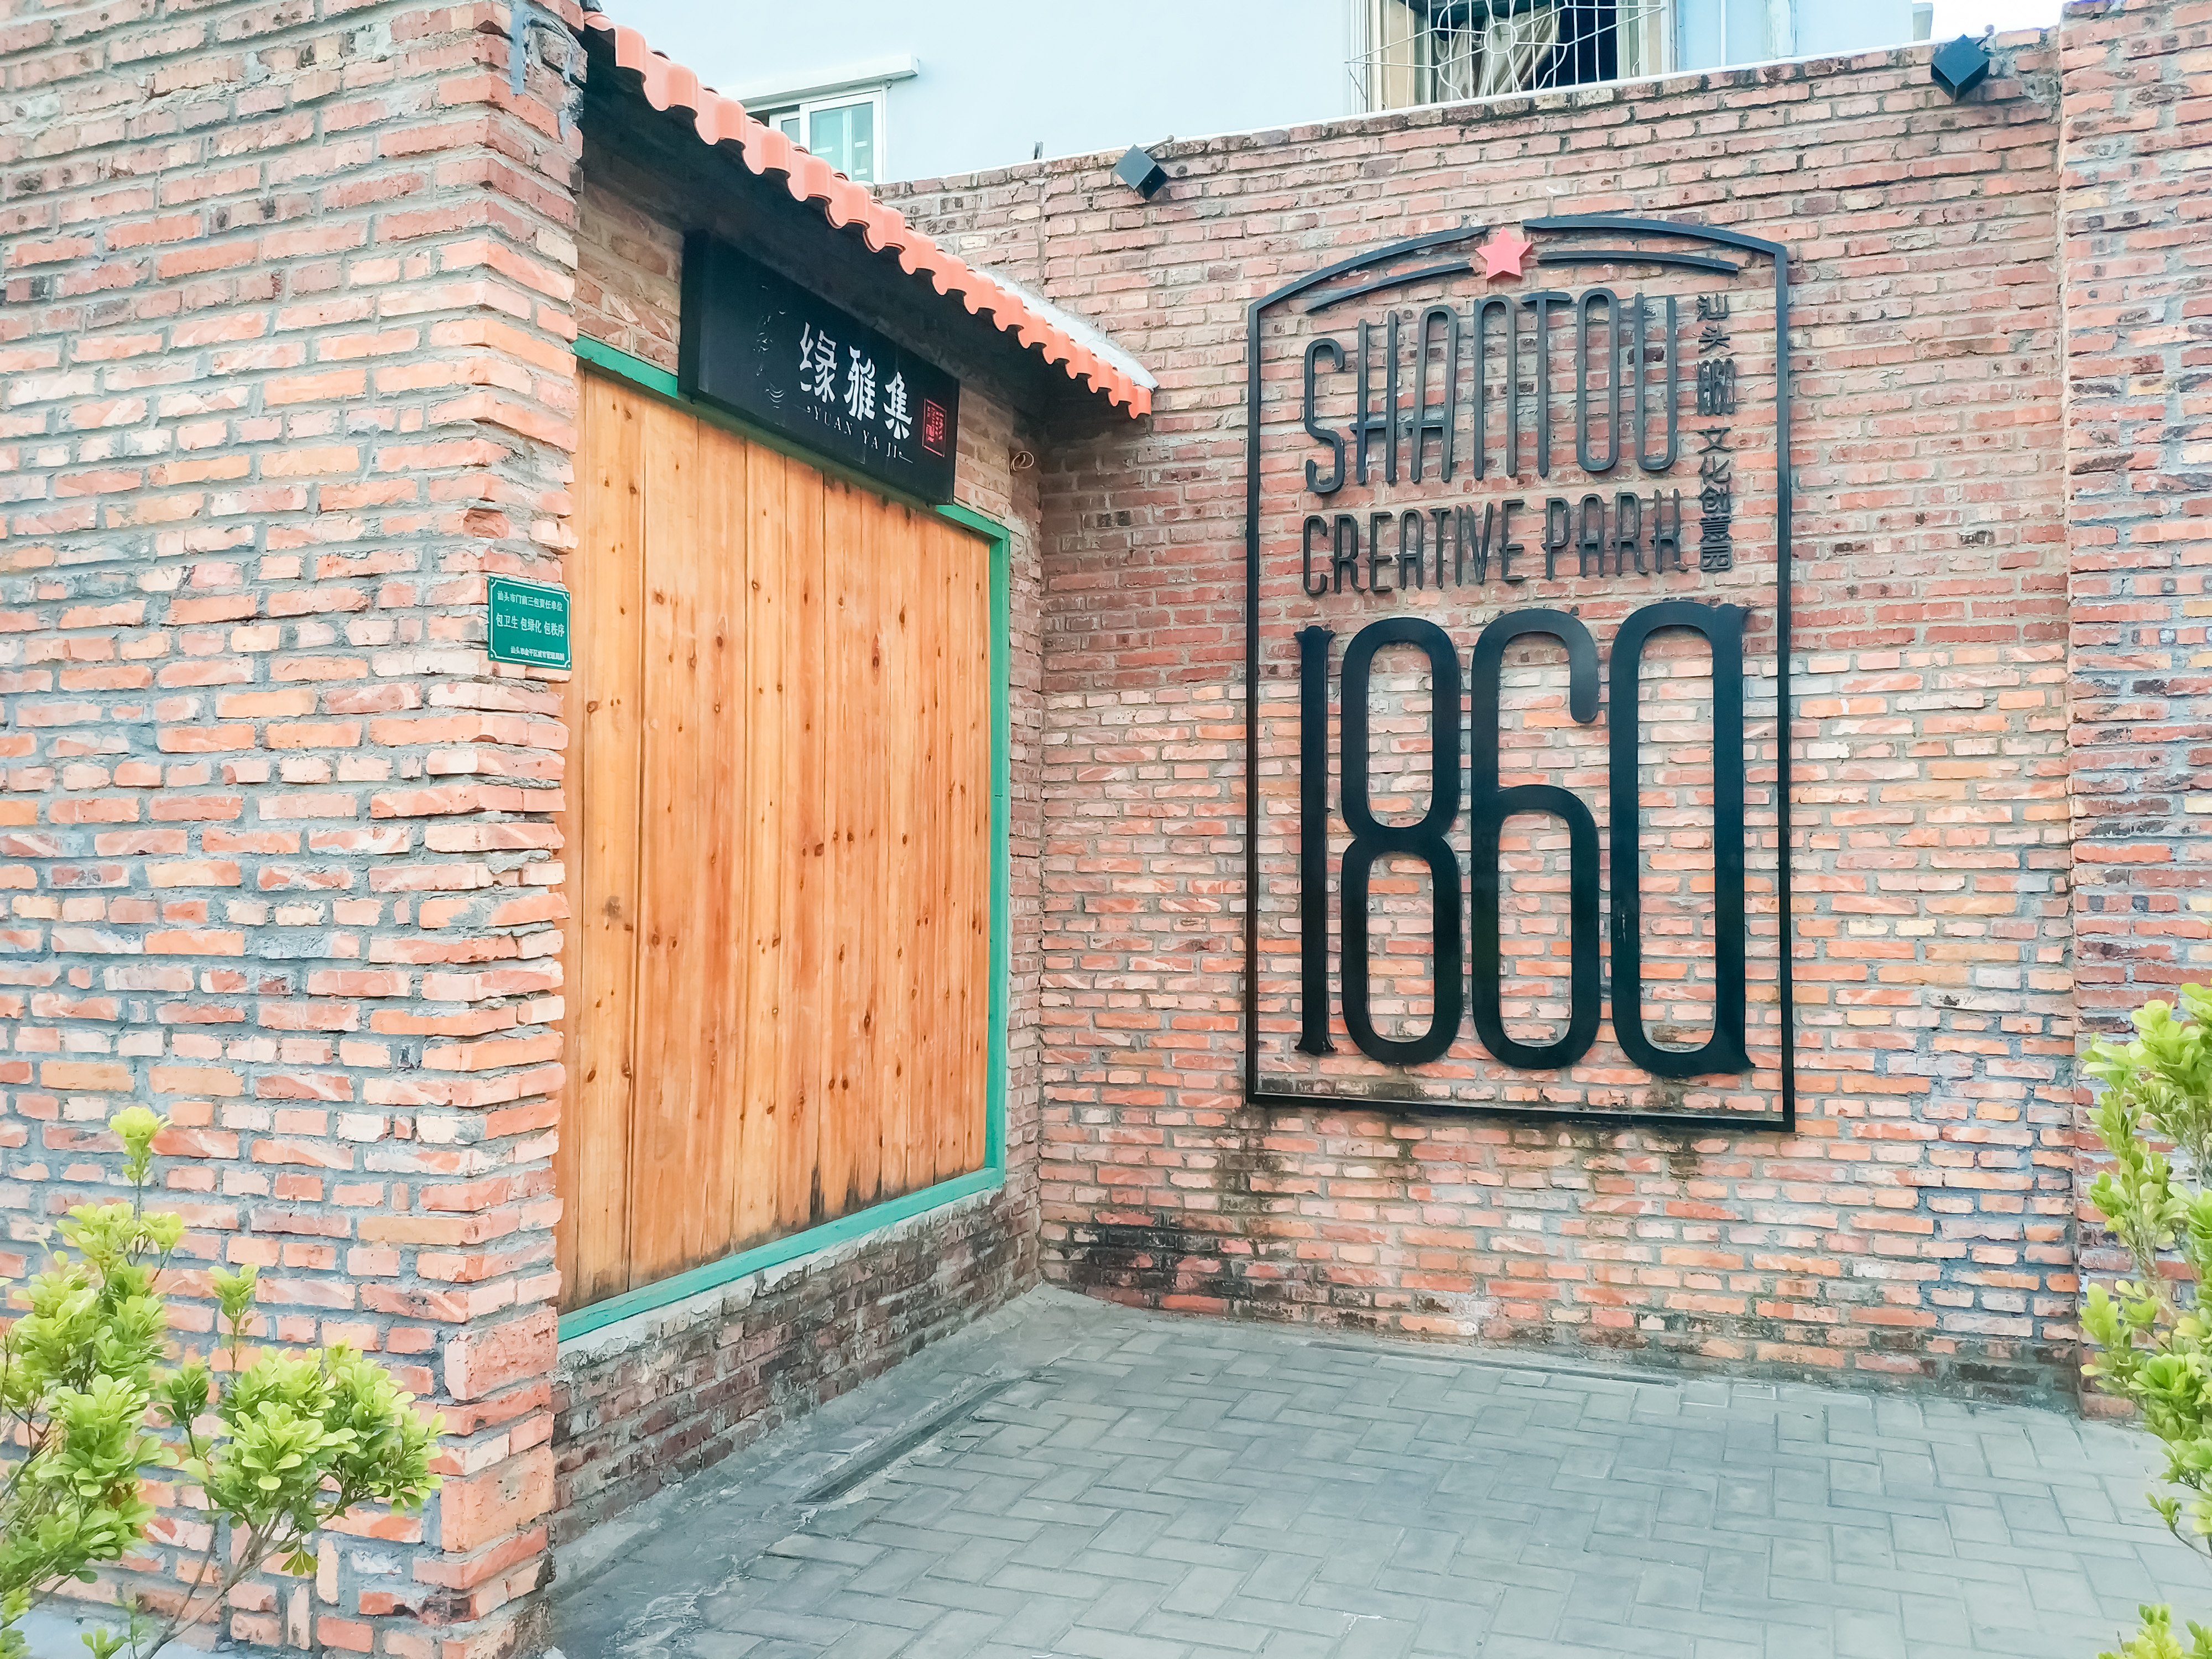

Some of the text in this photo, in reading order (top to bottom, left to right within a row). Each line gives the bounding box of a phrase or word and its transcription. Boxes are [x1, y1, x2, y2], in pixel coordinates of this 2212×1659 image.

[1303, 288, 1678, 494] SHANTOU
[1303, 488, 1688, 597] CREATIVE PARK
[495, 612, 565, 637] 包卫生 包绿化 包秩序
[1294, 600, 1755, 1077] 1860
